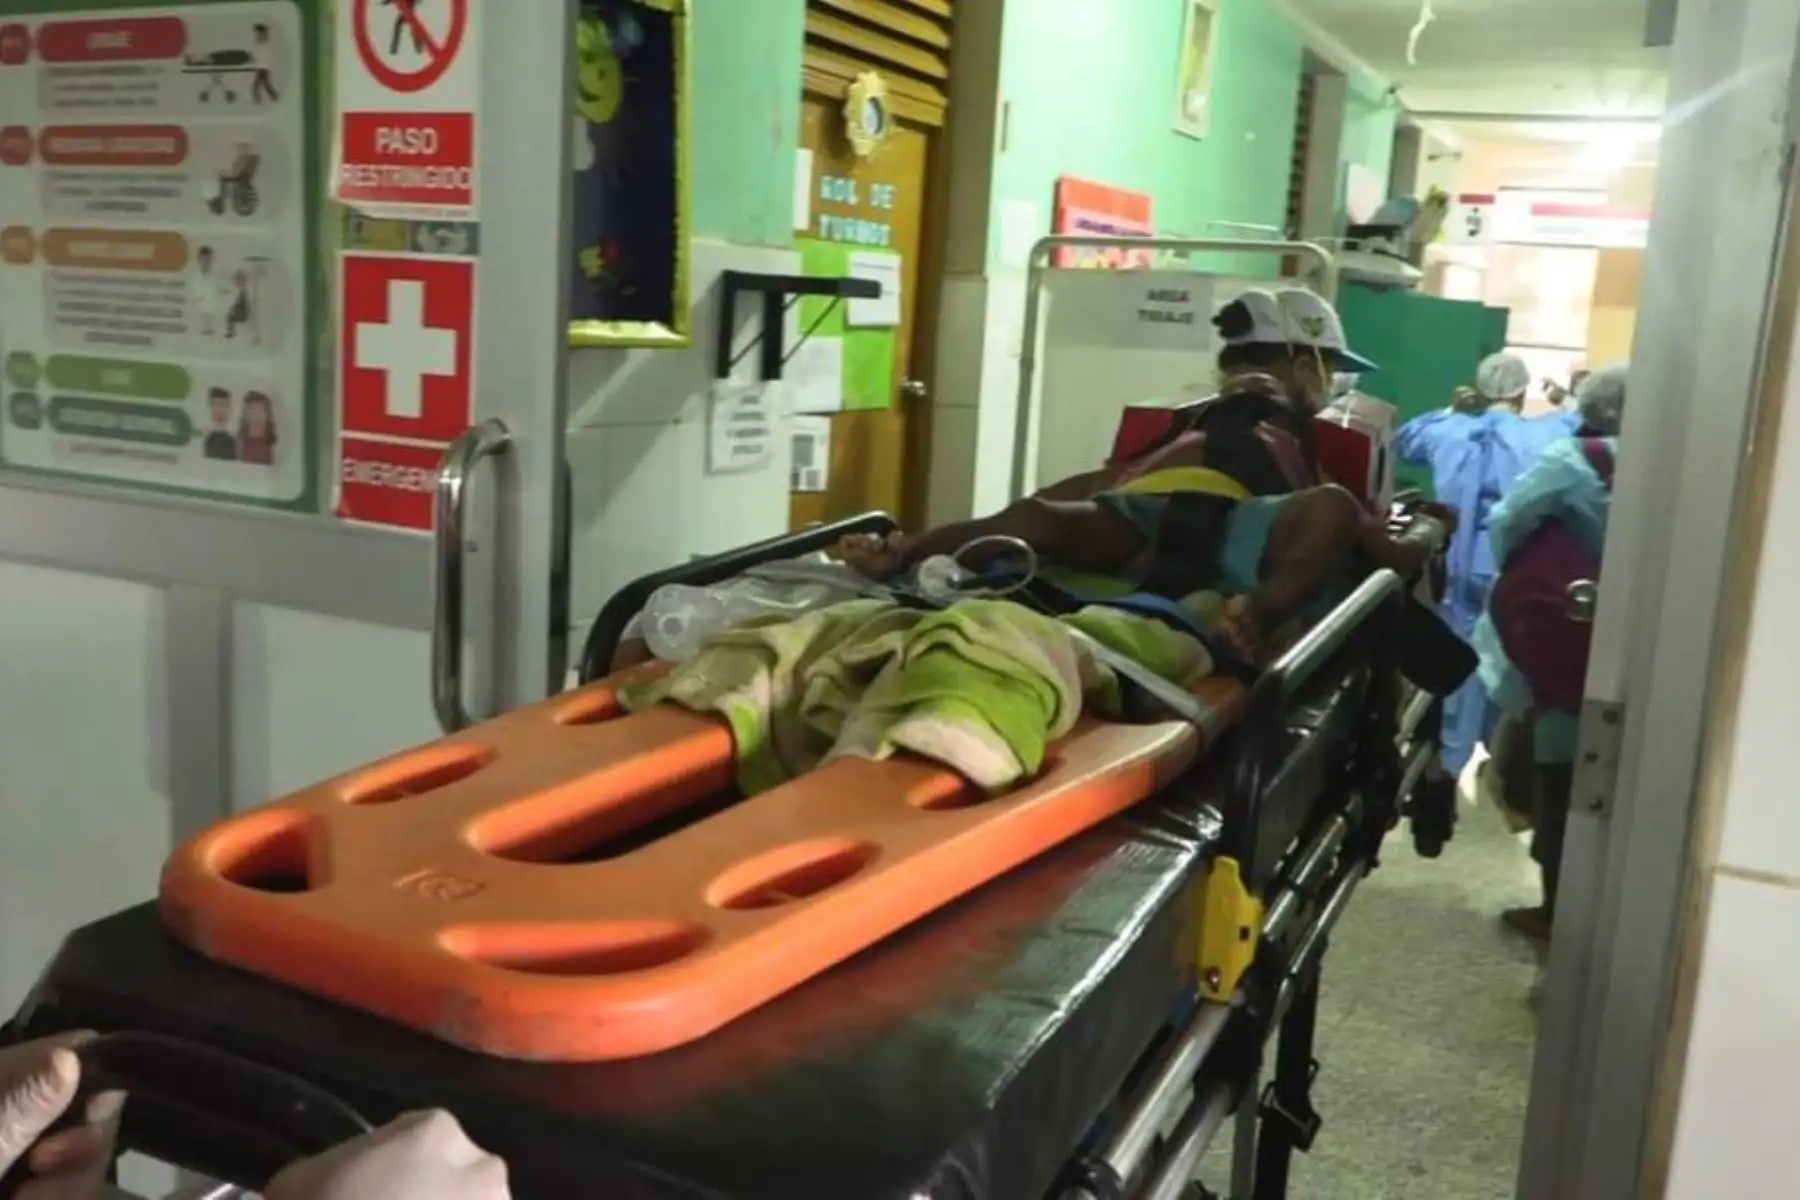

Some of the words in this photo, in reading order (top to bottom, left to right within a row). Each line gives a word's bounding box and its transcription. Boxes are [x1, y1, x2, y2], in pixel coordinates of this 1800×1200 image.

[374, 127, 439, 155] PASO
[820, 176, 858, 205] ROL
[870, 183, 895, 209] DE
[342, 457, 438, 493] EMERGEN
